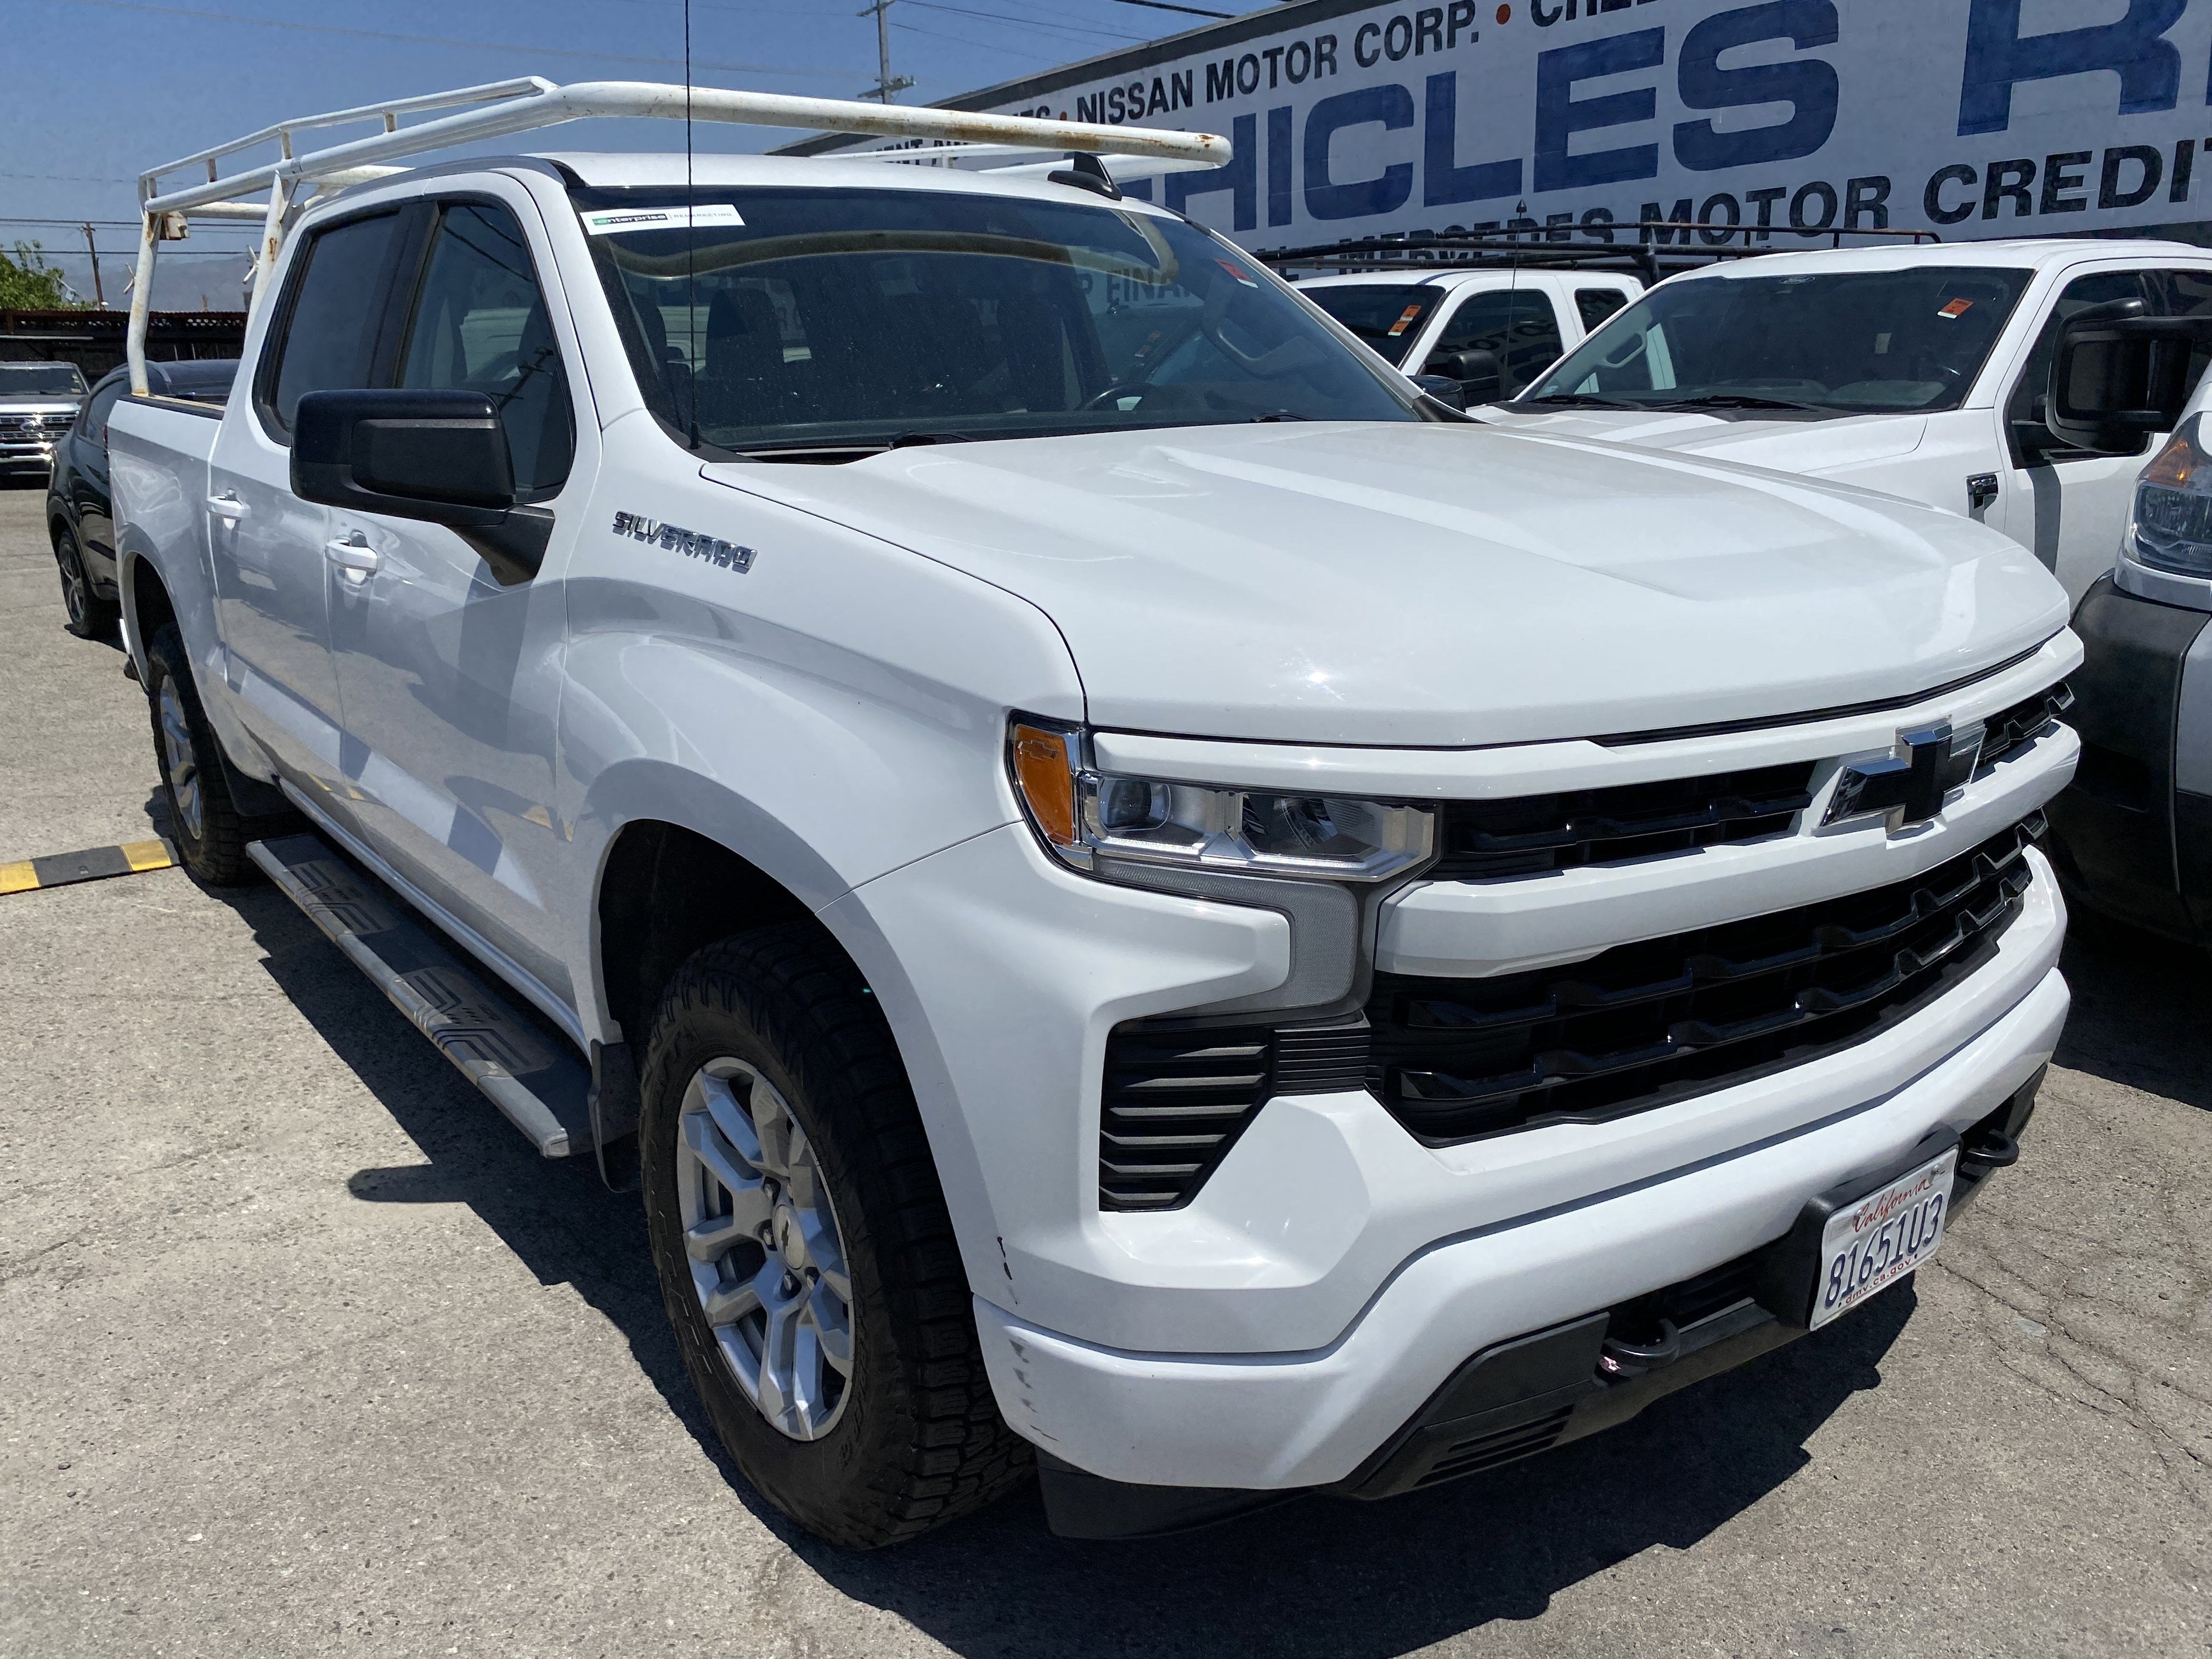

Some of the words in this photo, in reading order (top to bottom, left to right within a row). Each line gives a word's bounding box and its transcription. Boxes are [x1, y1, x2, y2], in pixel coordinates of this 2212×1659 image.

[1077, 69, 1193, 125] NISSAN
[1206, 34, 1338, 103] MOTOR
[1353, 0, 1479, 67] CORP.
[1116, 0, 1839, 232] HICLES
[1639, 176, 1891, 245] MOTOR
[1923, 137, 2212, 224] CREDI
[612, 510, 758, 571] SILVERADO
[1825, 1194, 1943, 1307] 81651U3
[1854, 1175, 1933, 1233] California
[1846, 1259, 1911, 1304] dmv.ca.gov
